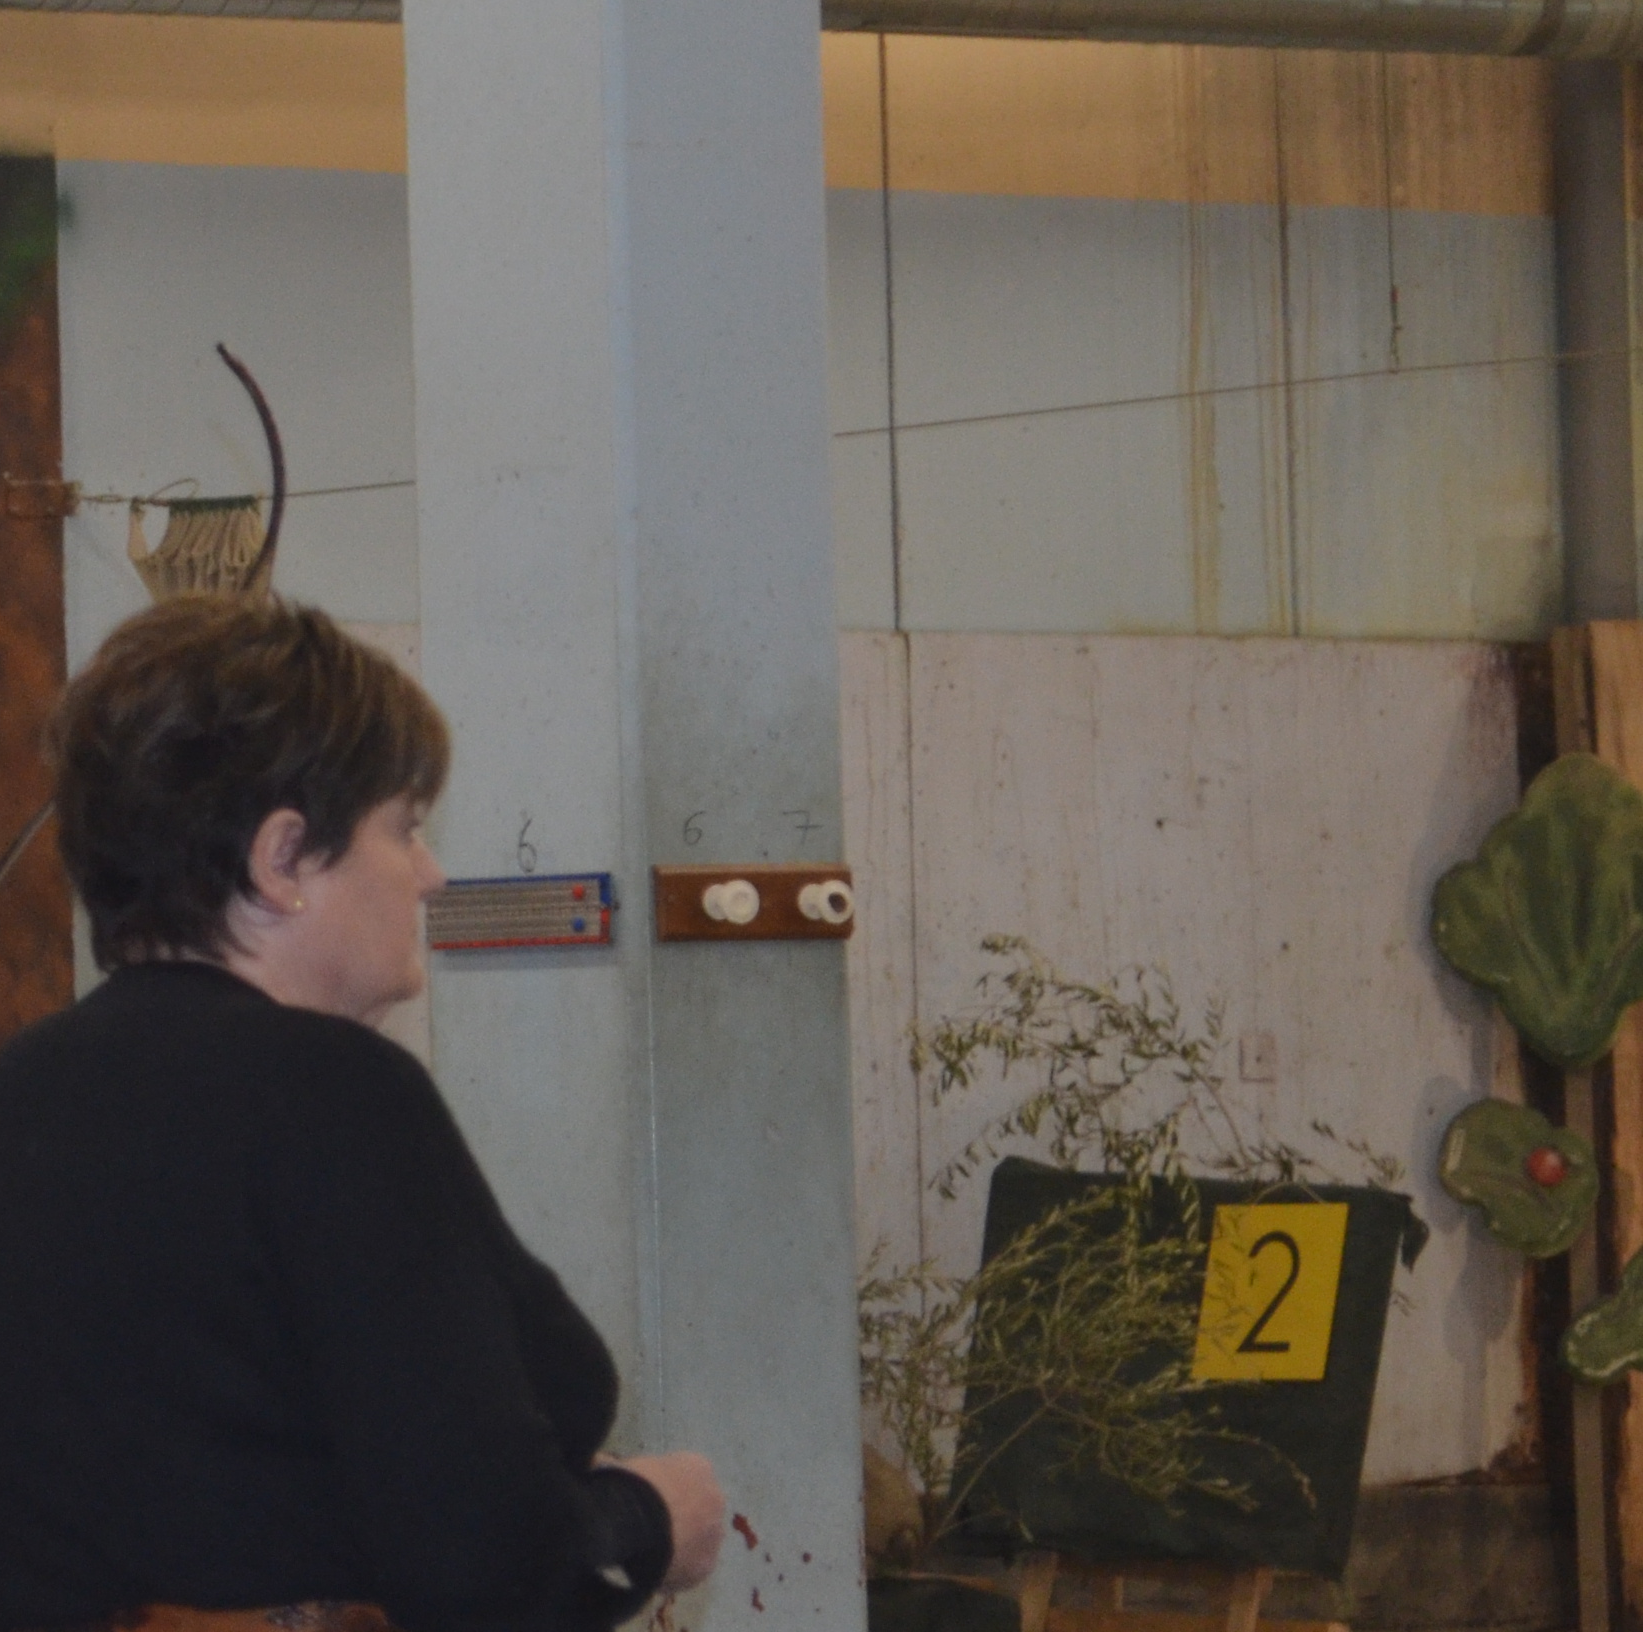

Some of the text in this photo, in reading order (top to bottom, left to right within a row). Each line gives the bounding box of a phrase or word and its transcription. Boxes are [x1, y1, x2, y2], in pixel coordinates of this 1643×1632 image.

[682, 809, 824, 846] 6 7
[1236, 1230, 1301, 1353] 2
